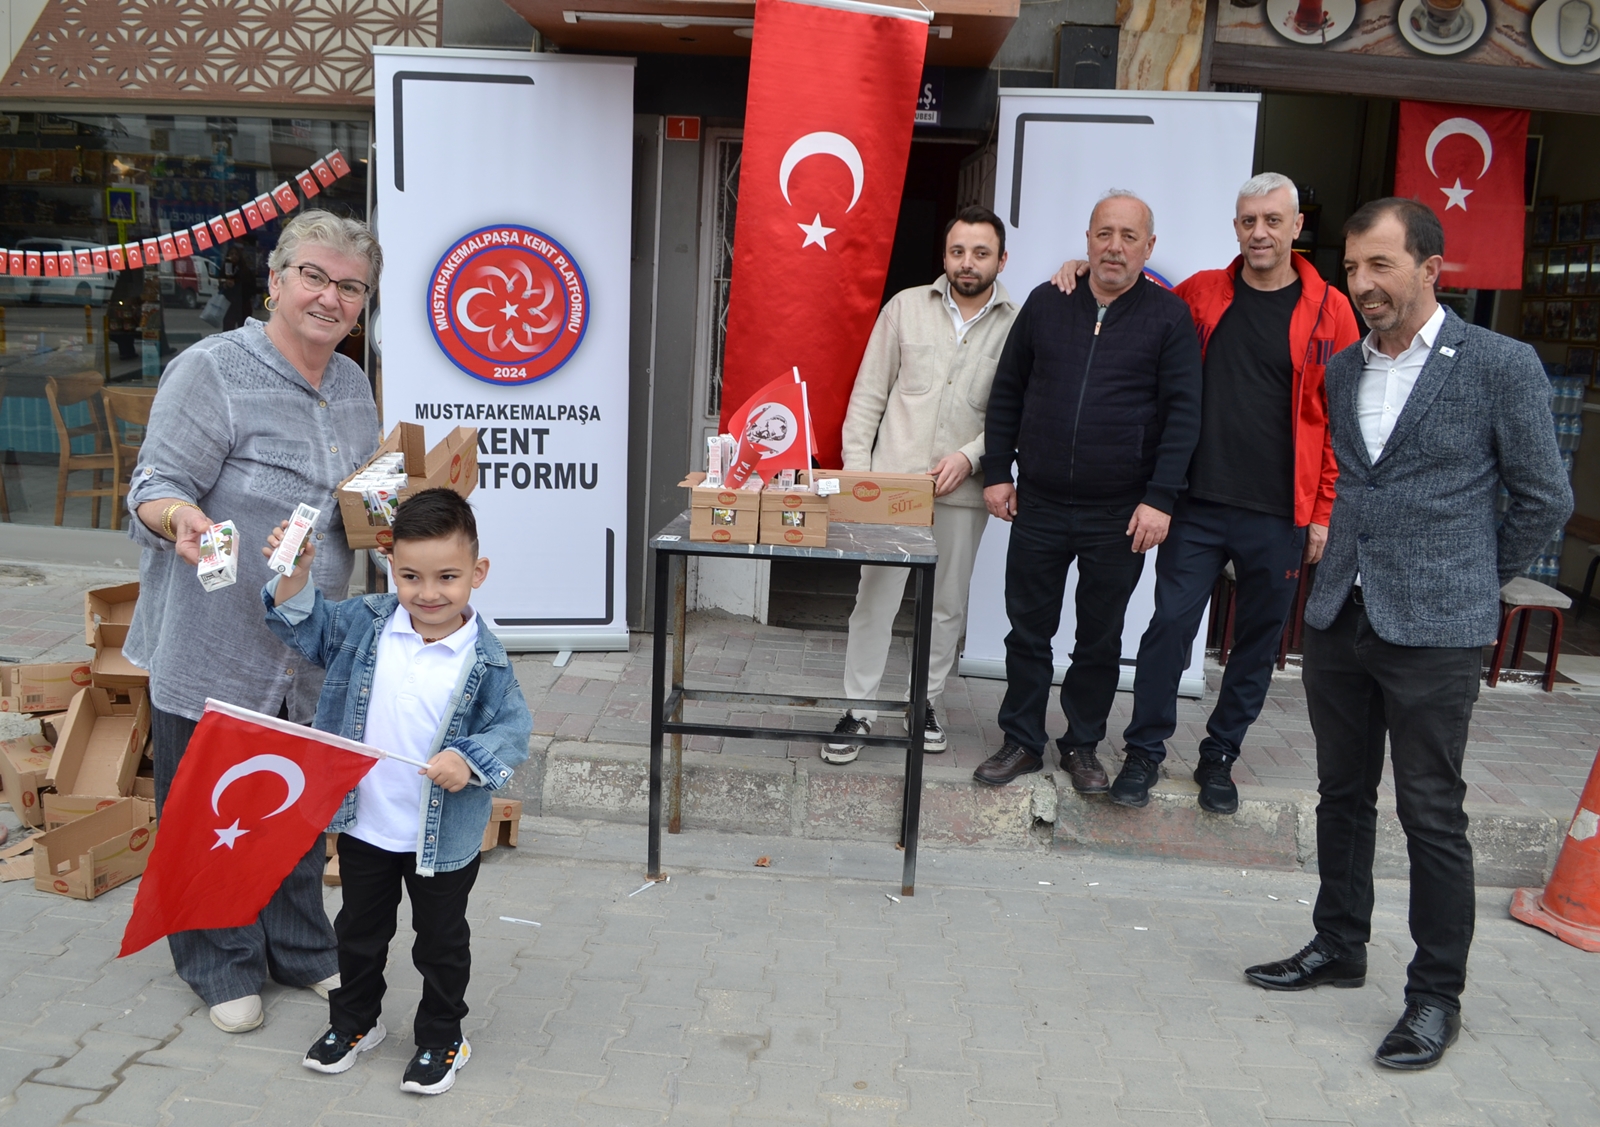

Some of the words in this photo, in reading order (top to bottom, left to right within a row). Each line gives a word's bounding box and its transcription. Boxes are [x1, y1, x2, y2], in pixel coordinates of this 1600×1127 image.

[917, 83, 936, 110] .Ş.
[915, 111, 935, 121] UBESİ
[678, 120, 685, 137] 1
[434, 231, 519, 331] MUSTAFAKEMALPAŞA
[523, 234, 557, 258] KENT
[554, 255, 582, 333] PLATFORMU
[493, 367, 527, 378] 2024
[415, 403, 601, 425] MUSTAFAKEMALPAŞA
[477, 428, 550, 455] KENT
[477, 462, 598, 490] TFORMU
[891, 499, 914, 515] SÜT
